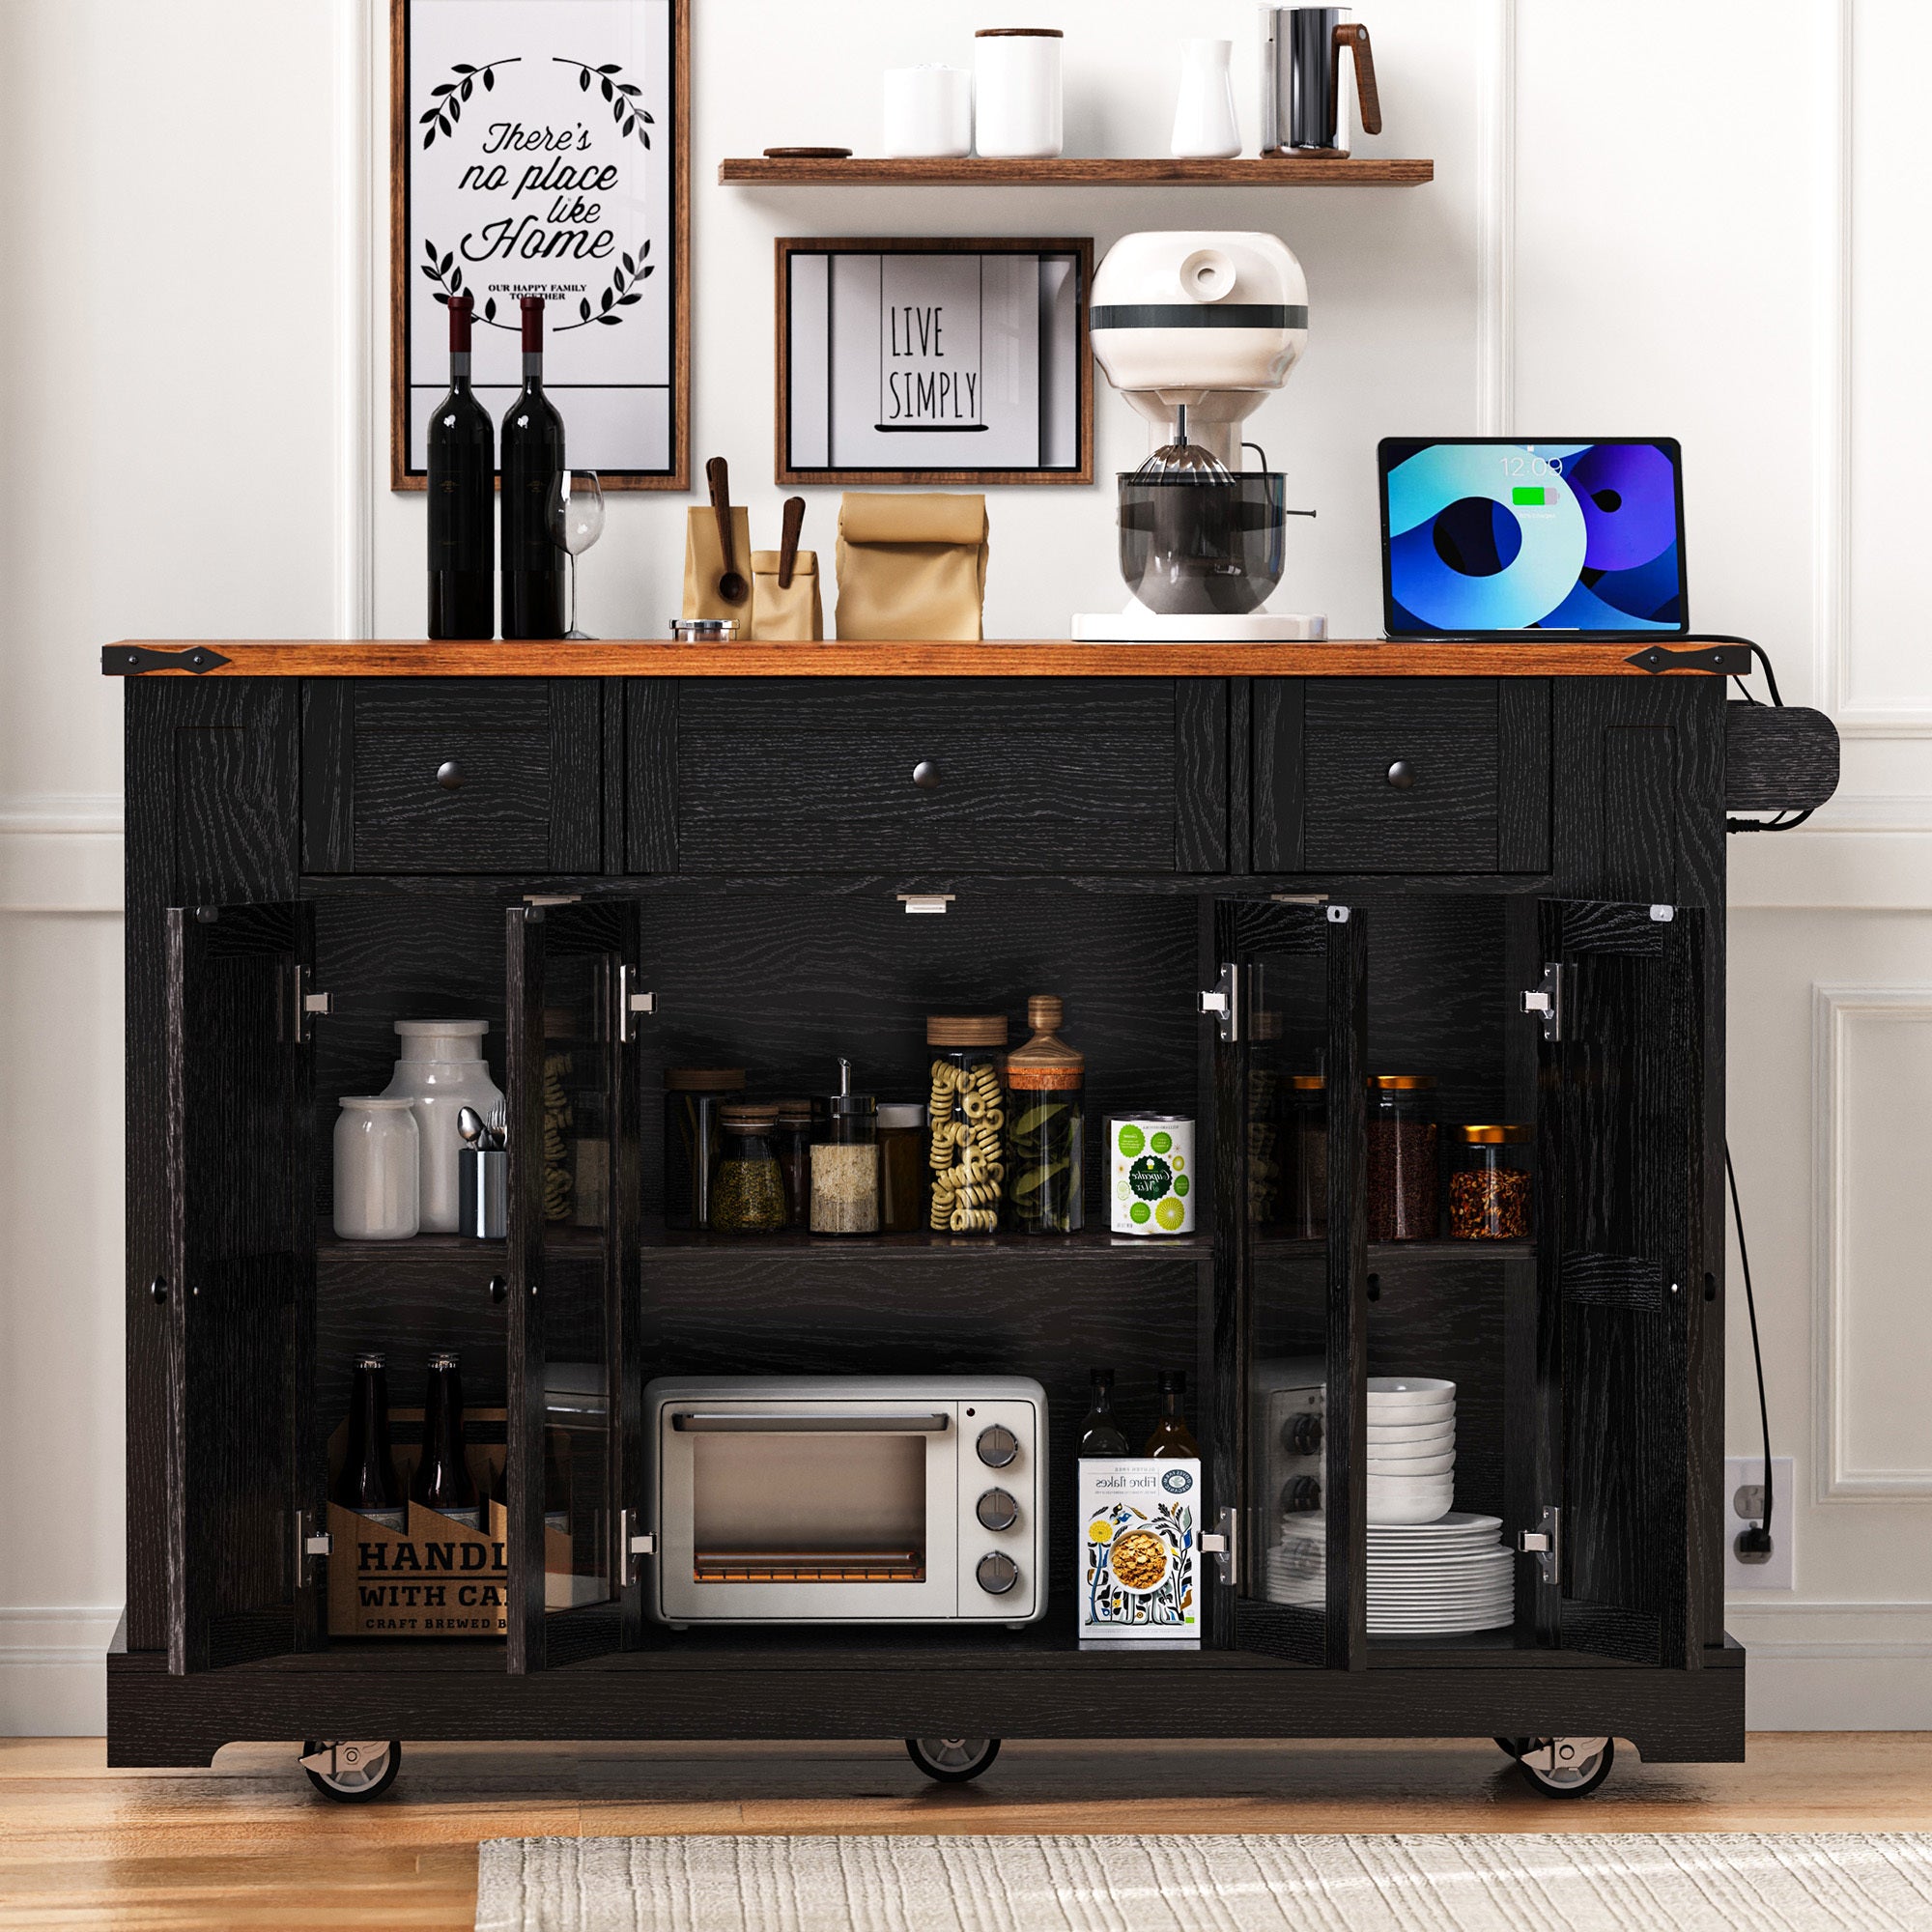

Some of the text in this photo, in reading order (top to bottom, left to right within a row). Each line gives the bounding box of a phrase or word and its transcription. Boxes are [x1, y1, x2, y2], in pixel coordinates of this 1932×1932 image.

[482, 122, 592, 154] There's
[458, 156, 618, 200] no place
[547, 195, 601, 223] like
[460, 214, 615, 262] Home
[891, 306, 945, 356] LIVE
[889, 371, 977, 419] SIMPLY
[1499, 456, 1564, 477] 12:09
[357, 1542, 508, 1571] HANDL
[357, 1585, 508, 1607] WITH CA
[365, 1618, 417, 1629] CRAFT
[424, 1618, 491, 1629] BREWED
